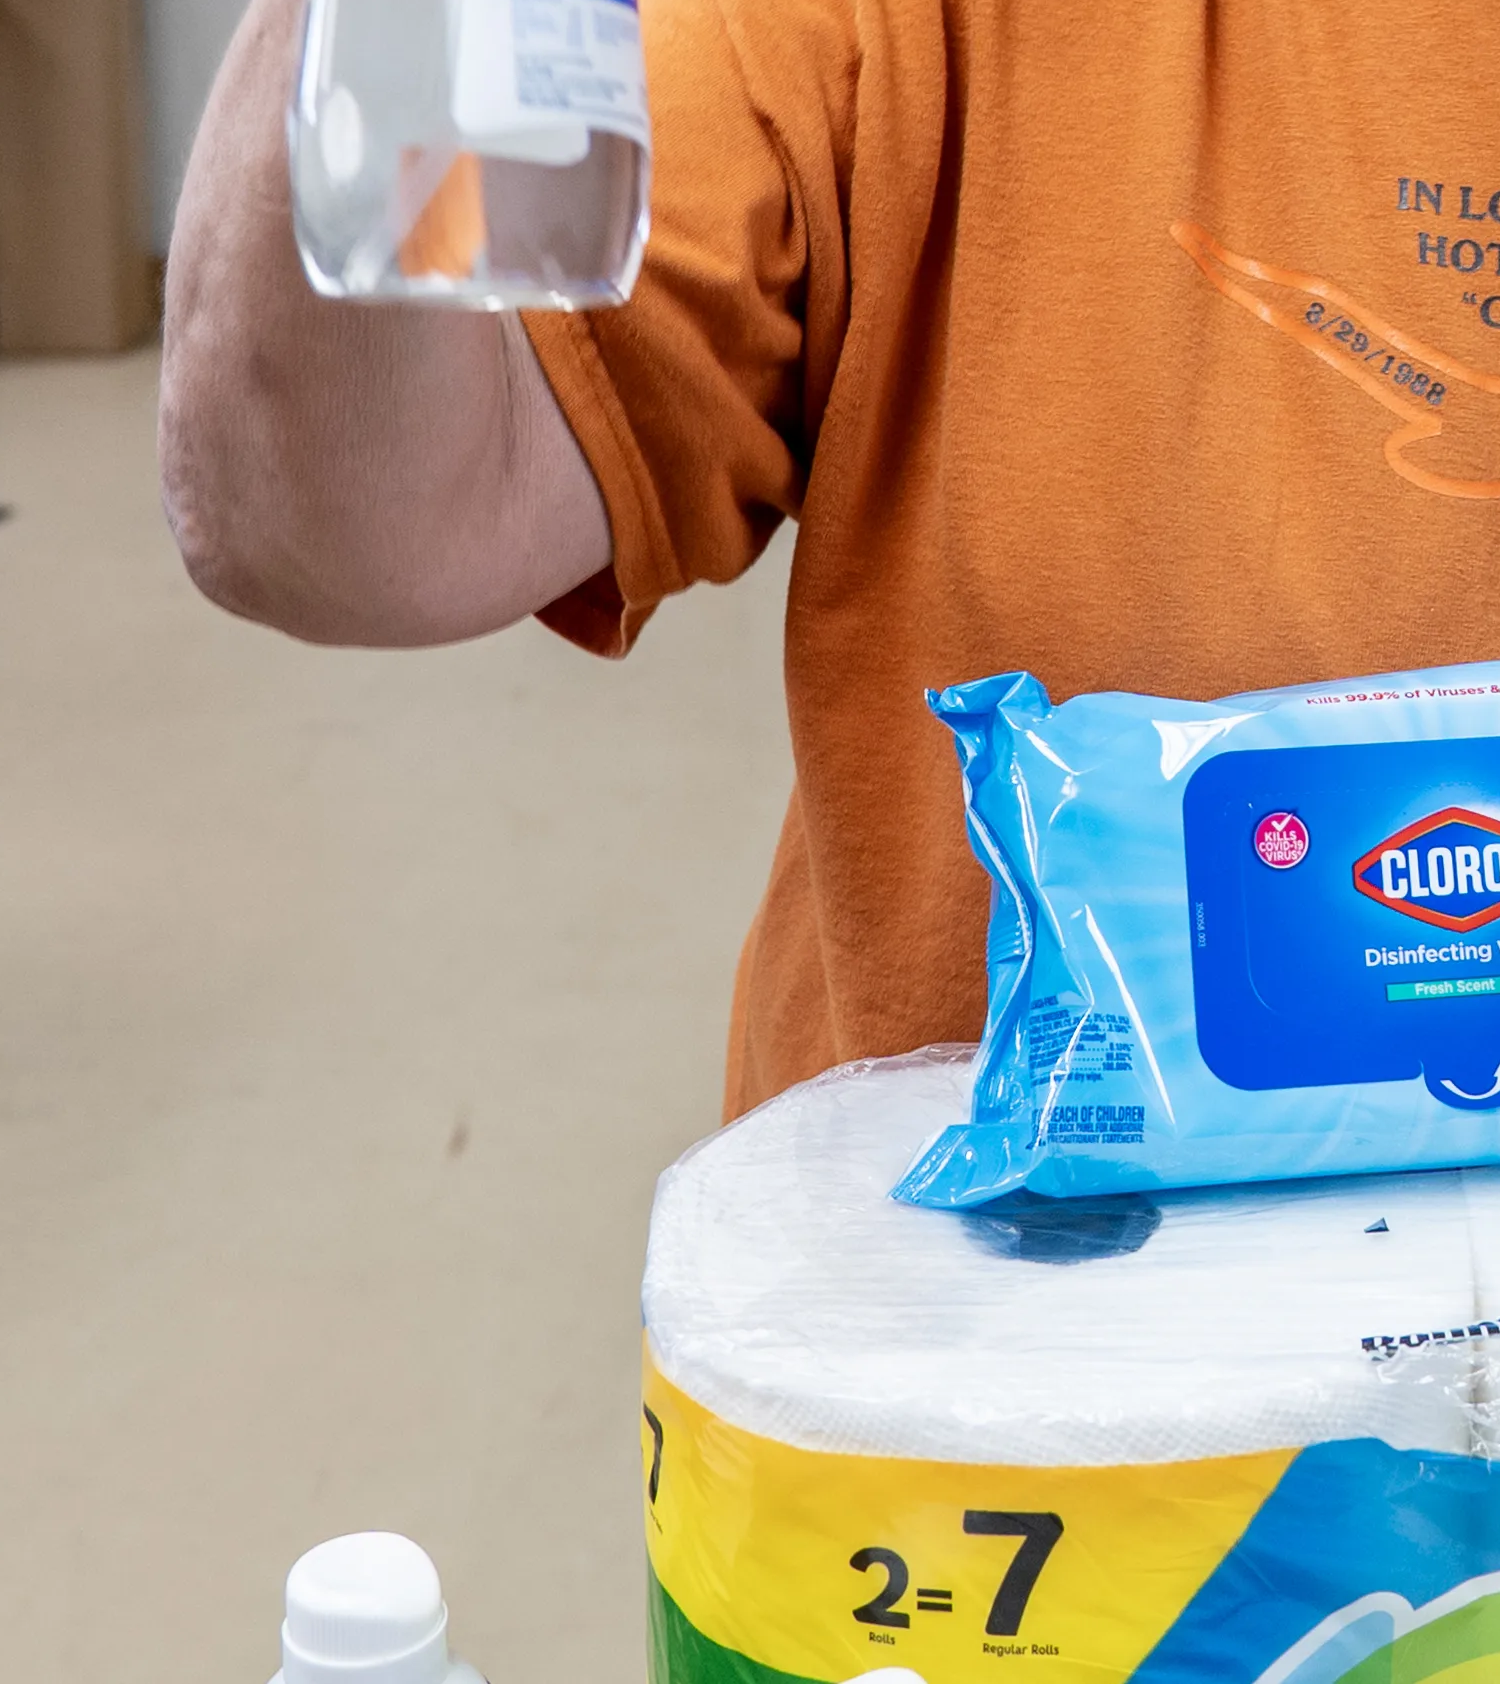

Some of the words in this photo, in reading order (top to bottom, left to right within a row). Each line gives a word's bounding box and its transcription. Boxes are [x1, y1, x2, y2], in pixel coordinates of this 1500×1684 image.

[1397, 177, 1444, 215] IN
[1305, 302, 1446, 405] 8/29/1988
[1345, 691, 1400, 702] 99.9%
[1404, 689, 1421, 699] of
[1264, 830, 1297, 842] KILLS
[1258, 839, 1304, 852] COVID-19
[1365, 943, 1492, 967] Disinfecting
[1414, 980, 1454, 996] Fresh
[1456, 978, 1495, 993] Scent
[1081, 1105, 1094, 1122] OF
[1096, 1105, 1144, 1122] CHILDREN
[868, 1631, 896, 1646] Rolls
[982, 1642, 1028, 1657] Regular
[1031, 1642, 1060, 1656] Rolls
